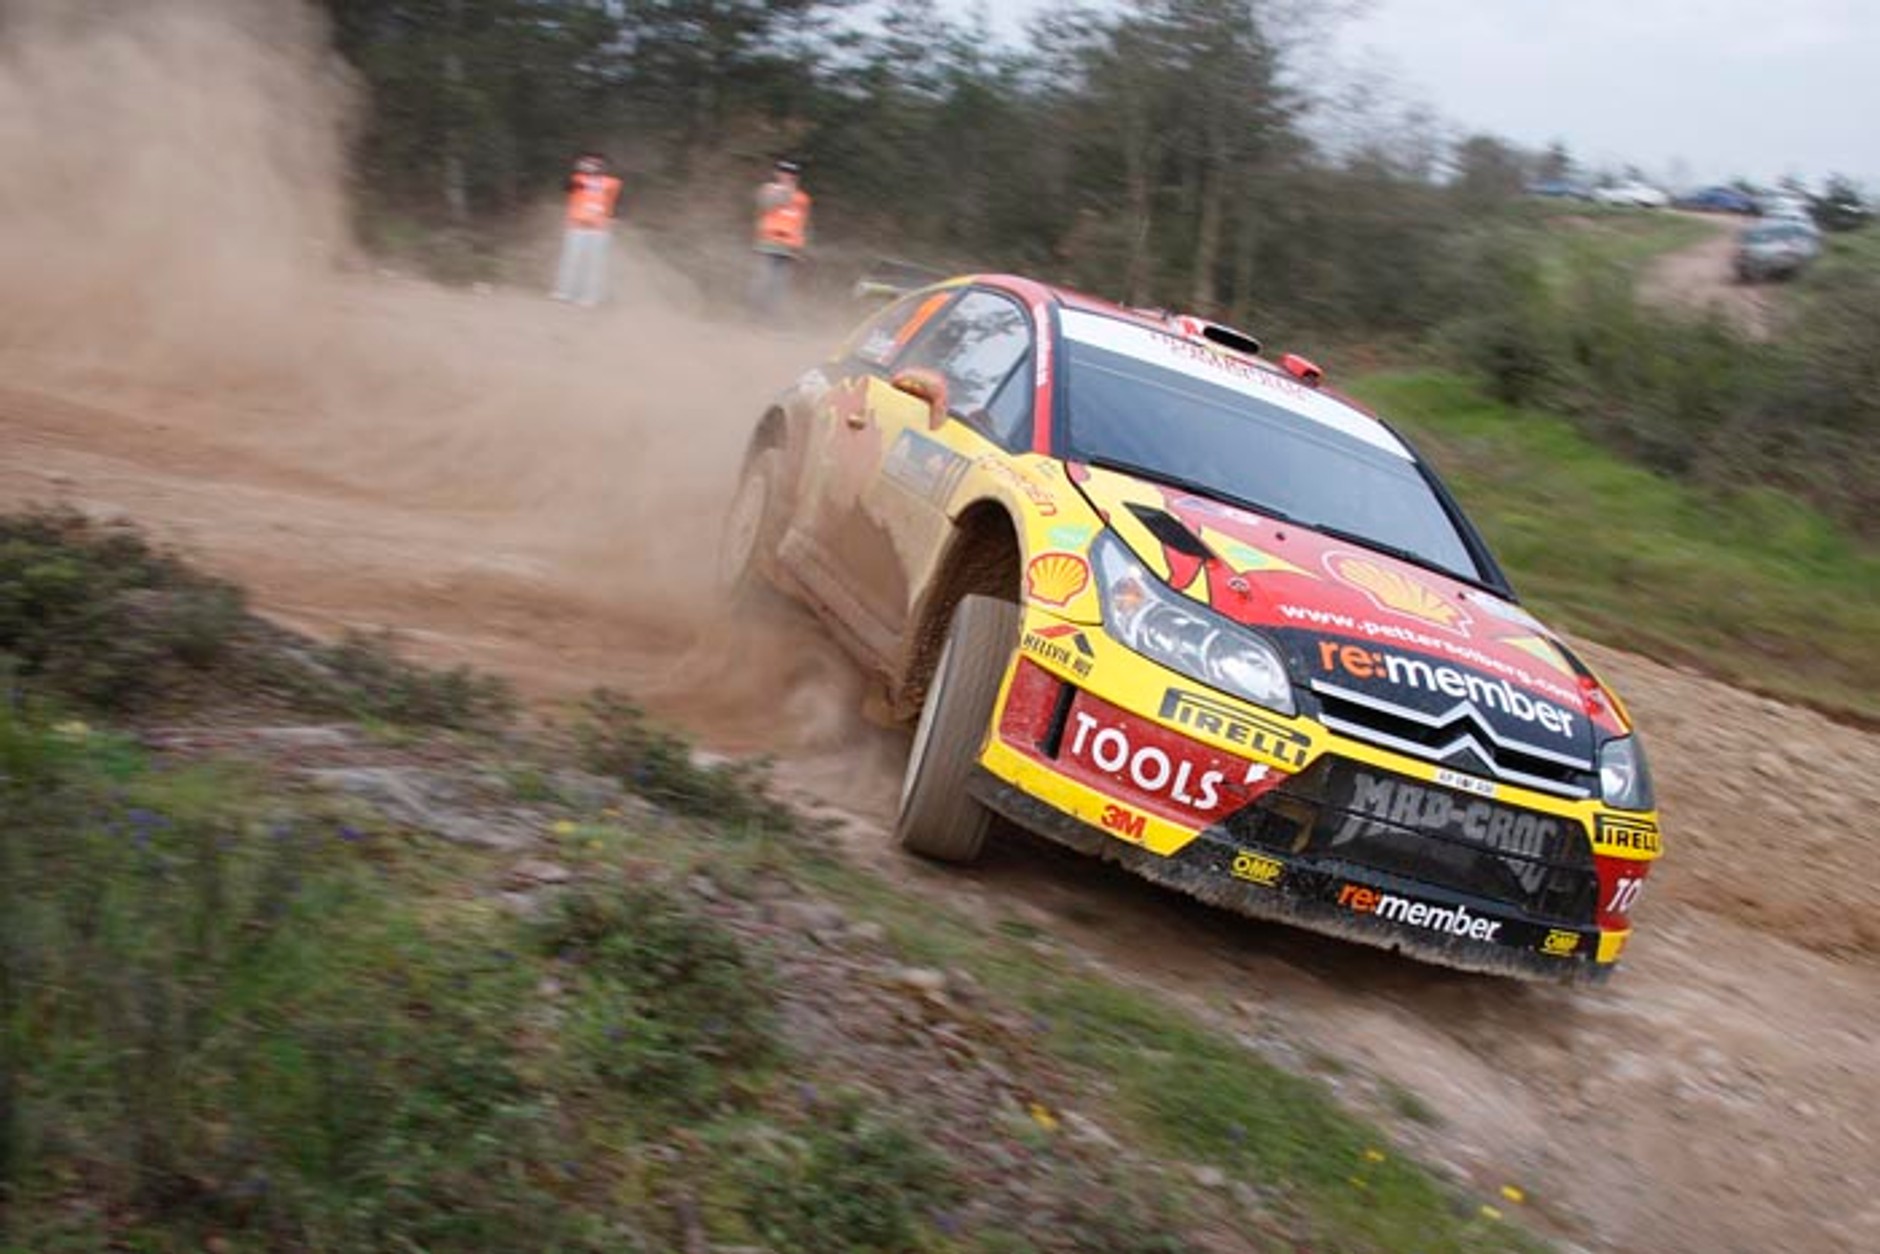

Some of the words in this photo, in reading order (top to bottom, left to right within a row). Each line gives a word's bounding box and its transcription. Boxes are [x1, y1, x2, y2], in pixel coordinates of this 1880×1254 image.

[1318, 640, 1575, 738] re:member
[1157, 687, 1312, 767] PIRELLI
[1071, 711, 1225, 811] TOOLS
[1101, 804, 1147, 840] 3M
[1593, 813, 1658, 852] PIRELL
[1232, 852, 1281, 884] OMP
[1336, 883, 1501, 942] re:member
